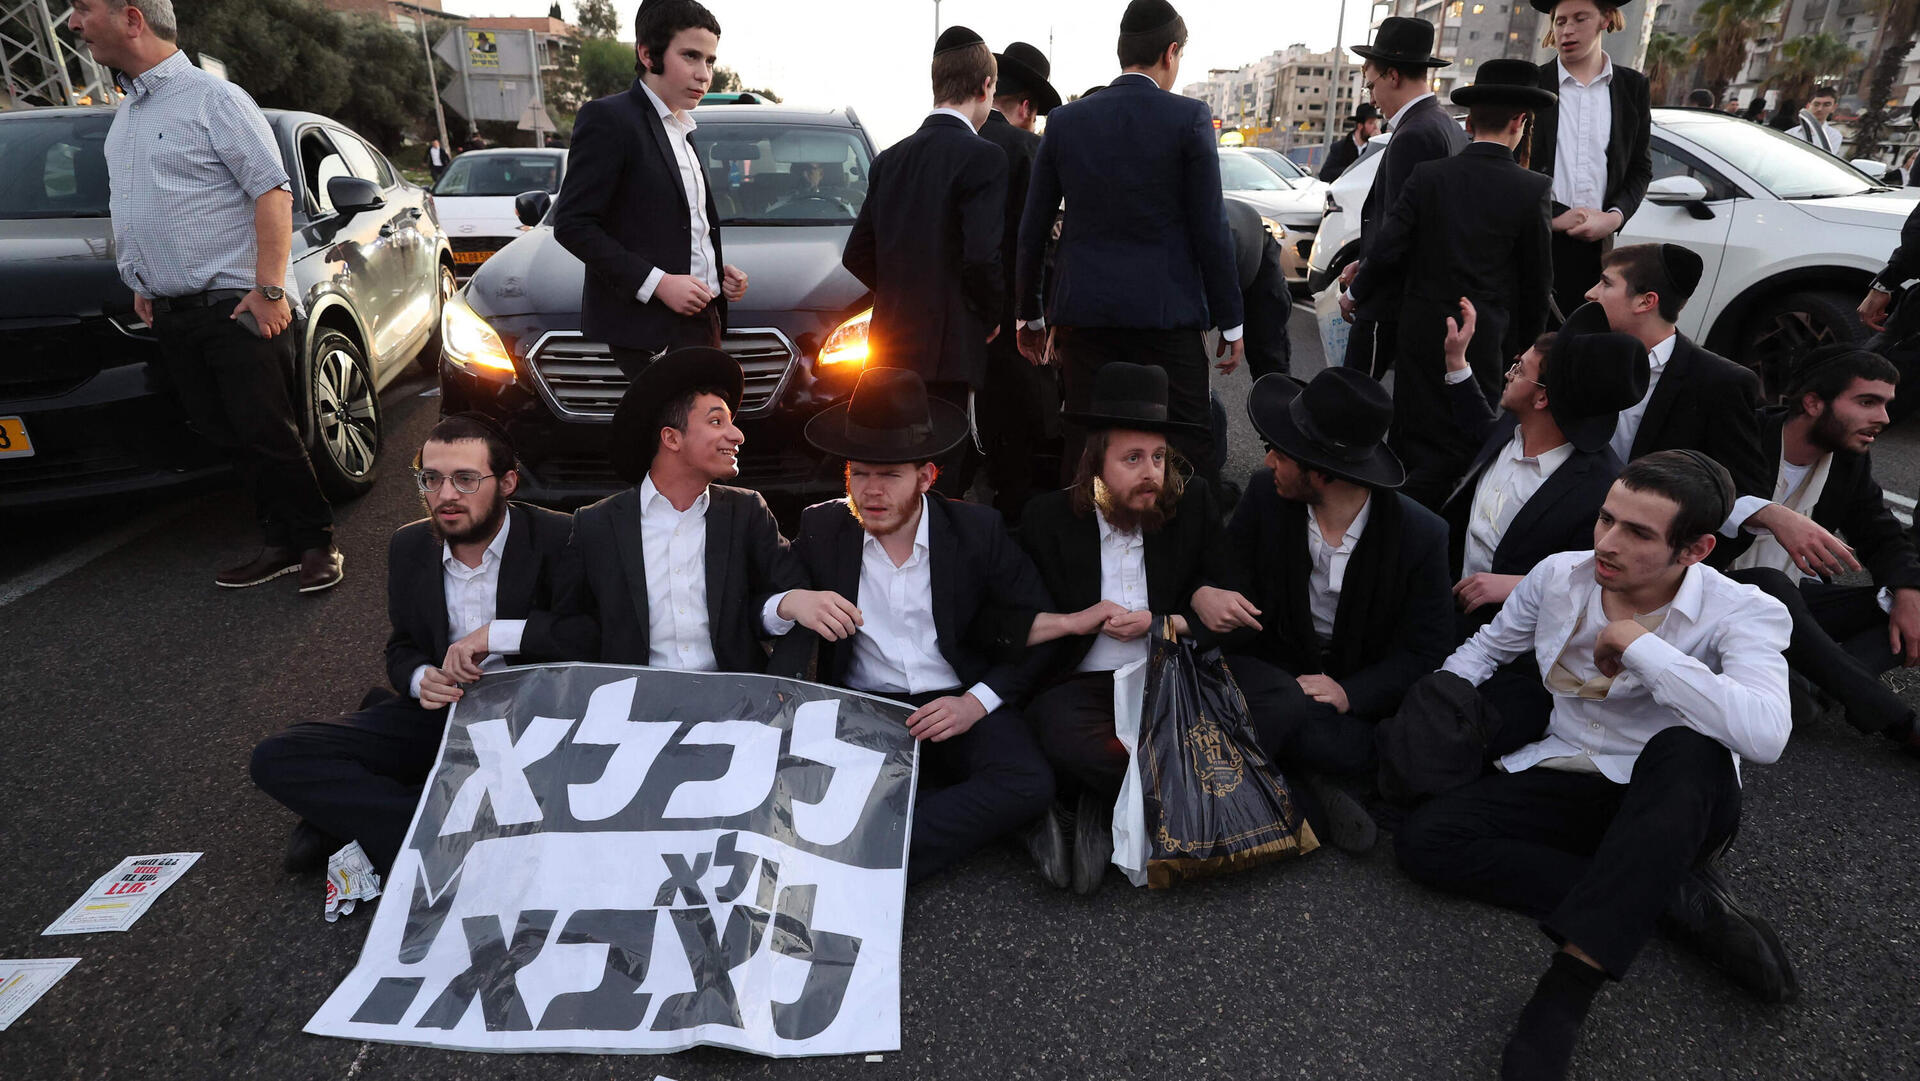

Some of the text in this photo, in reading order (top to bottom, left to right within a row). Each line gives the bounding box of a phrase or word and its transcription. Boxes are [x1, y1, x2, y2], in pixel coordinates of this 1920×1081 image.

[438, 676, 887, 846] לכלא
[349, 856, 863, 1041] לצבא!
[653, 831, 780, 909] ולא
